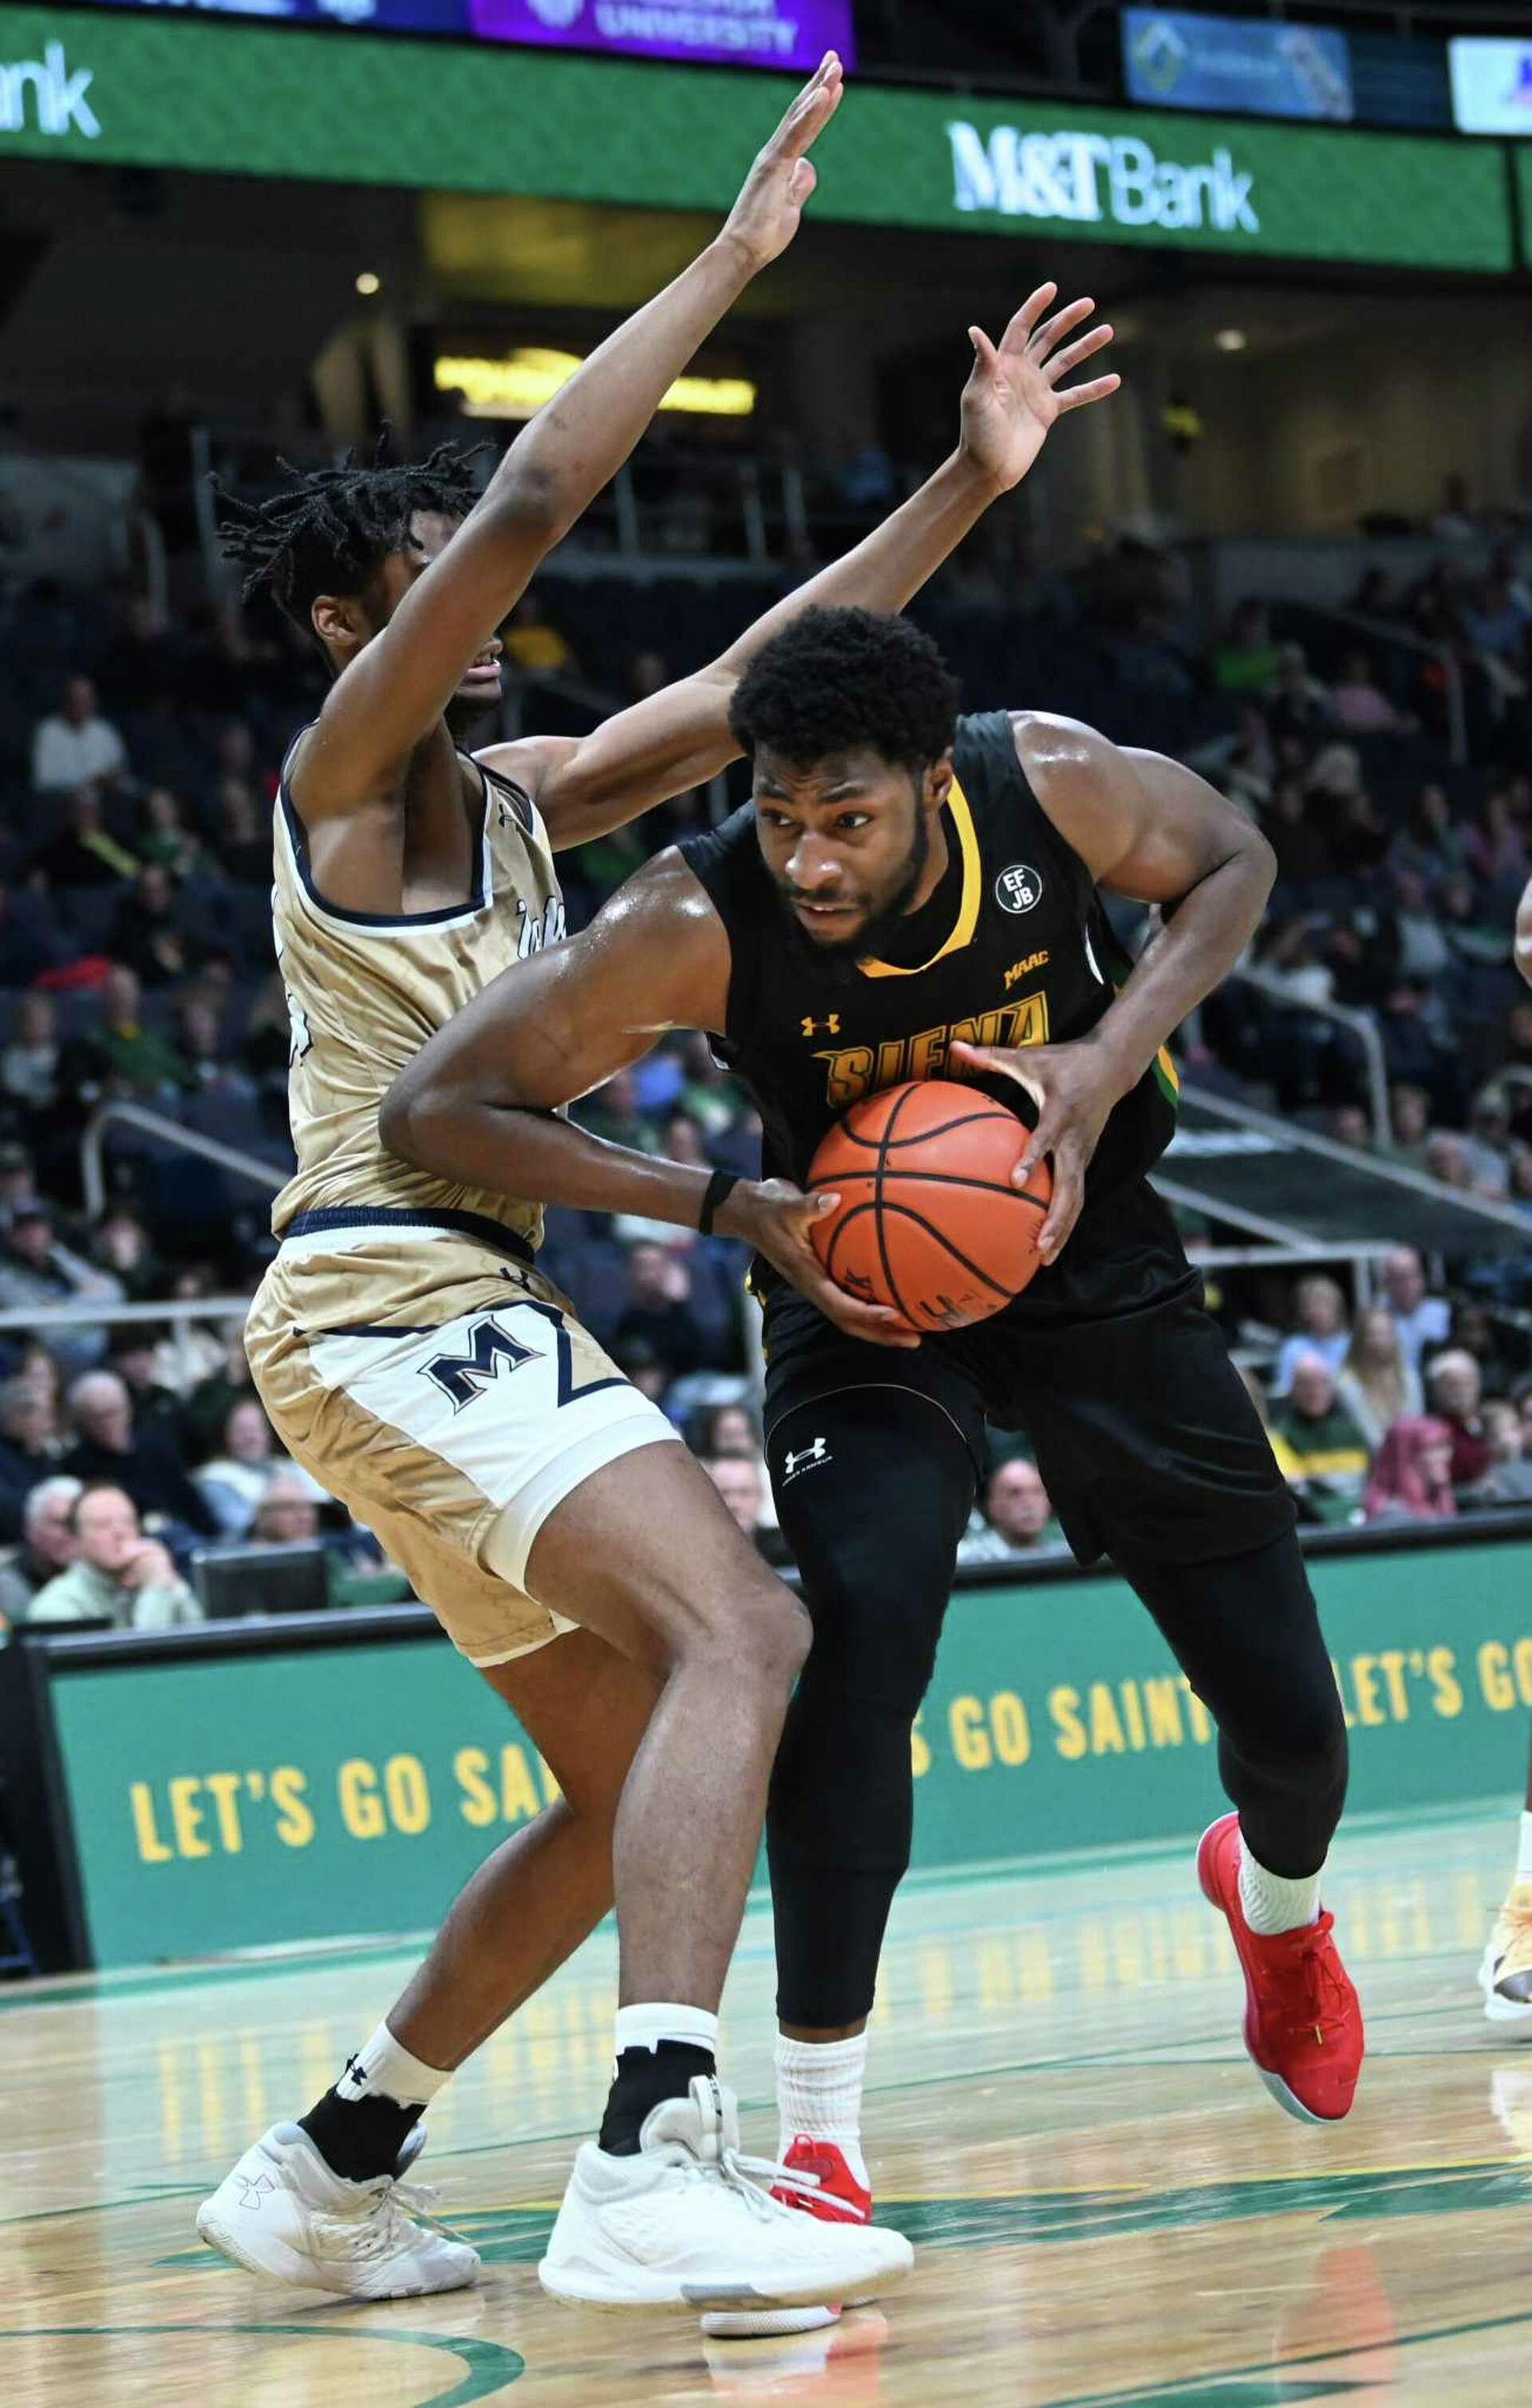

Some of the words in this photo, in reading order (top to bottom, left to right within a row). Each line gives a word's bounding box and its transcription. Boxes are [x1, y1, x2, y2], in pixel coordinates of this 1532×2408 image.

[1003, 868, 1025, 892] EF
[1013, 886, 1034, 910] JB
[1004, 950, 1049, 990] MAAC
[811, 990, 1050, 1108] SIENA
[417, 1313, 547, 1415] M
[949, 1691, 1031, 1771] GO
[130, 1766, 315, 1862] LET'S
[338, 1753, 431, 1839] GO
